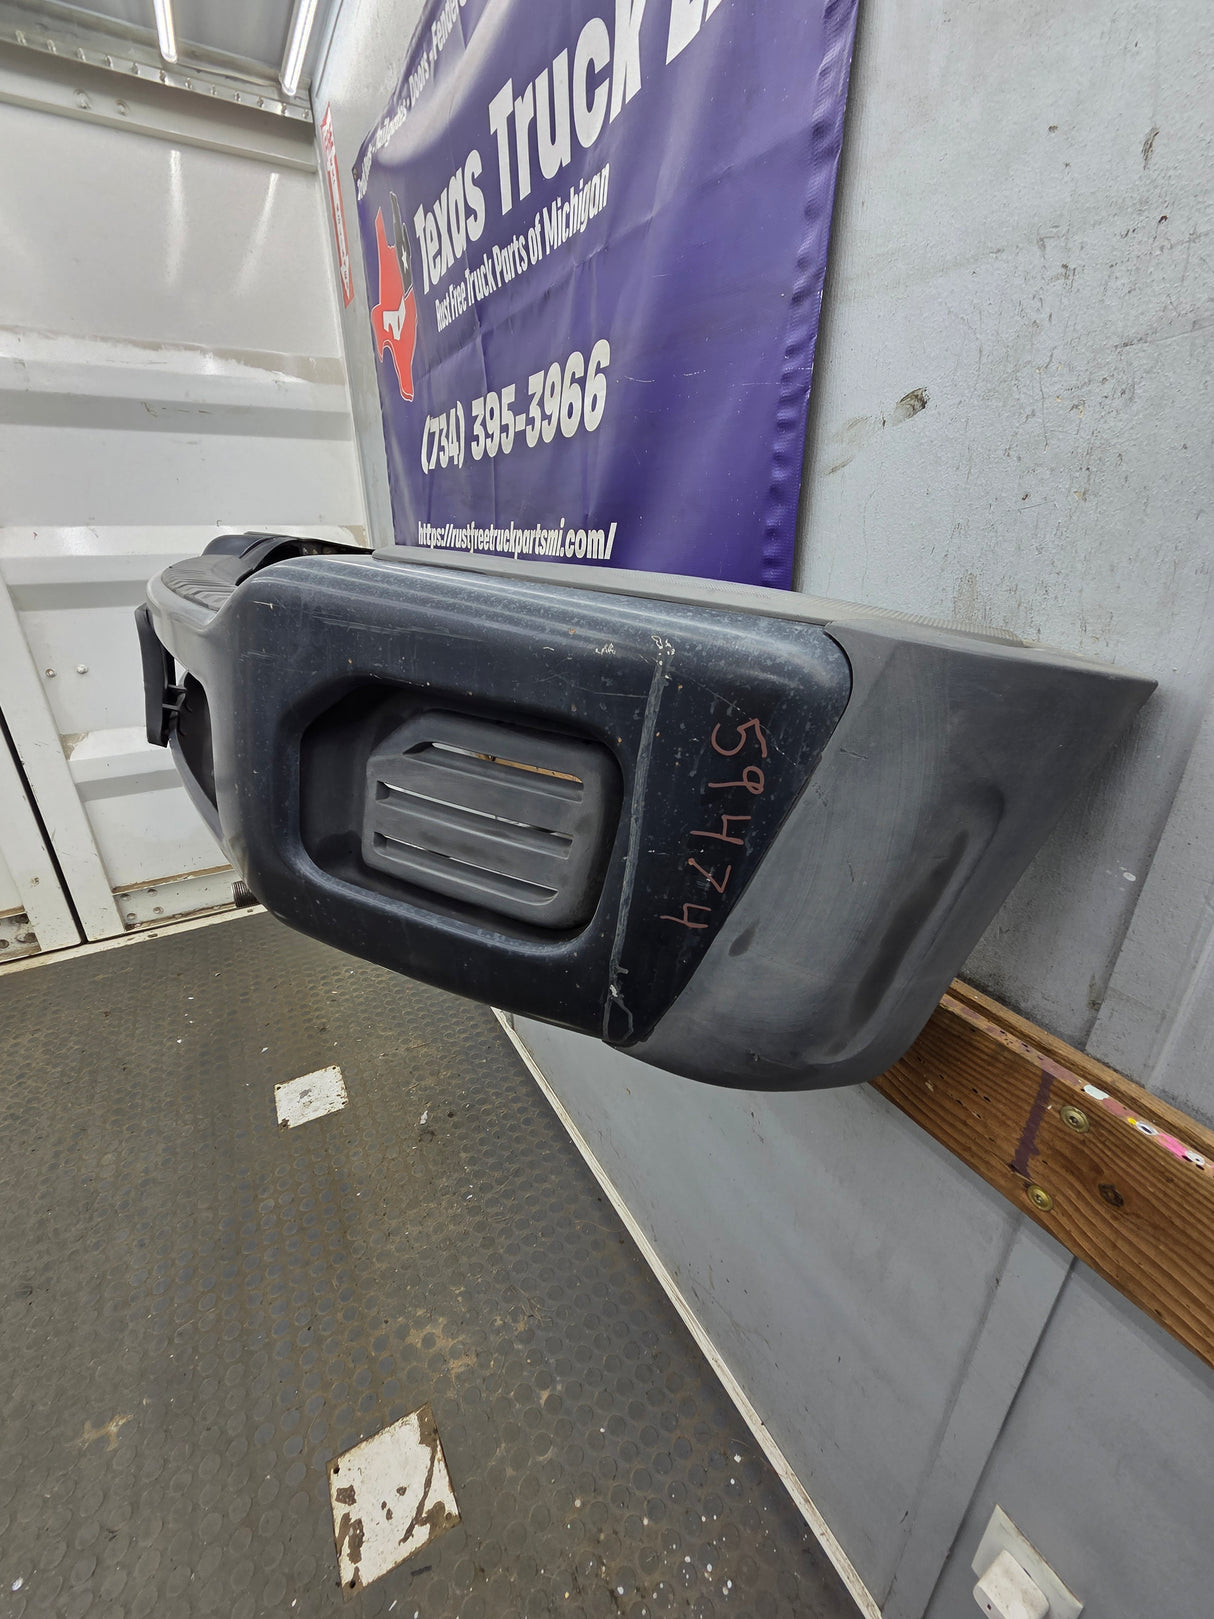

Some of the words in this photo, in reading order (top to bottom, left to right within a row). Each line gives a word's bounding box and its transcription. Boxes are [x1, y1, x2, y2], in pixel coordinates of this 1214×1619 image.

[413, 149, 486, 295] Texas
[488, 0, 647, 216] Truck
[435, 292, 452, 333] Rust
[449, 281, 468, 321] Free
[465, 253, 497, 307] Truck
[492, 234, 528, 288] Parts
[528, 211, 543, 265] of
[542, 162, 610, 256] Michigan
[420, 400, 465, 475] (734)
[470, 338, 611, 461] 395-3966
[418, 517, 618, 560] https://rustfreetruckpartsmi.com/
